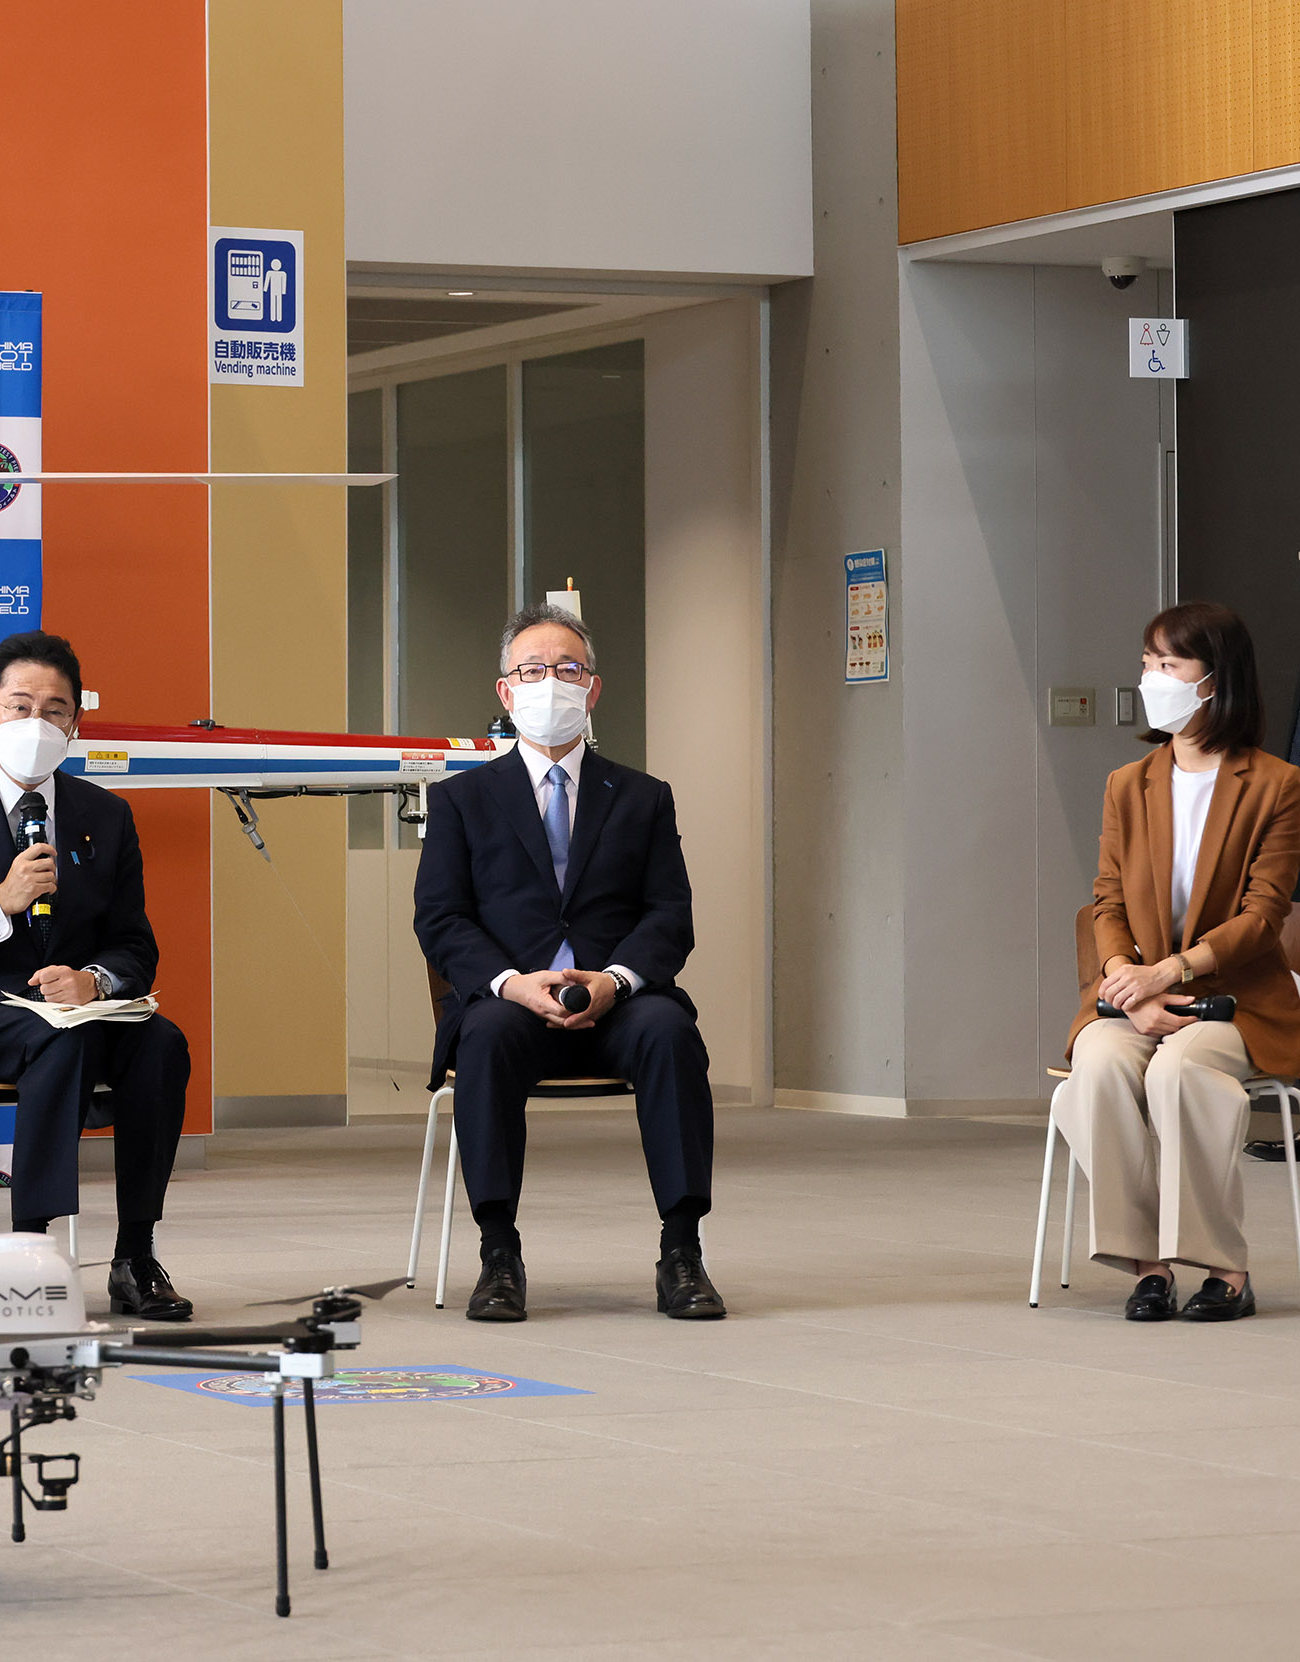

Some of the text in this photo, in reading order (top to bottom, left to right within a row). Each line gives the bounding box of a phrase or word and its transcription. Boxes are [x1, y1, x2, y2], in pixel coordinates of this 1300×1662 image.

[214, 340, 296, 361] 自動販売機
[215, 360, 296, 377] Vending machine
[0, 448, 14, 460] TEST
